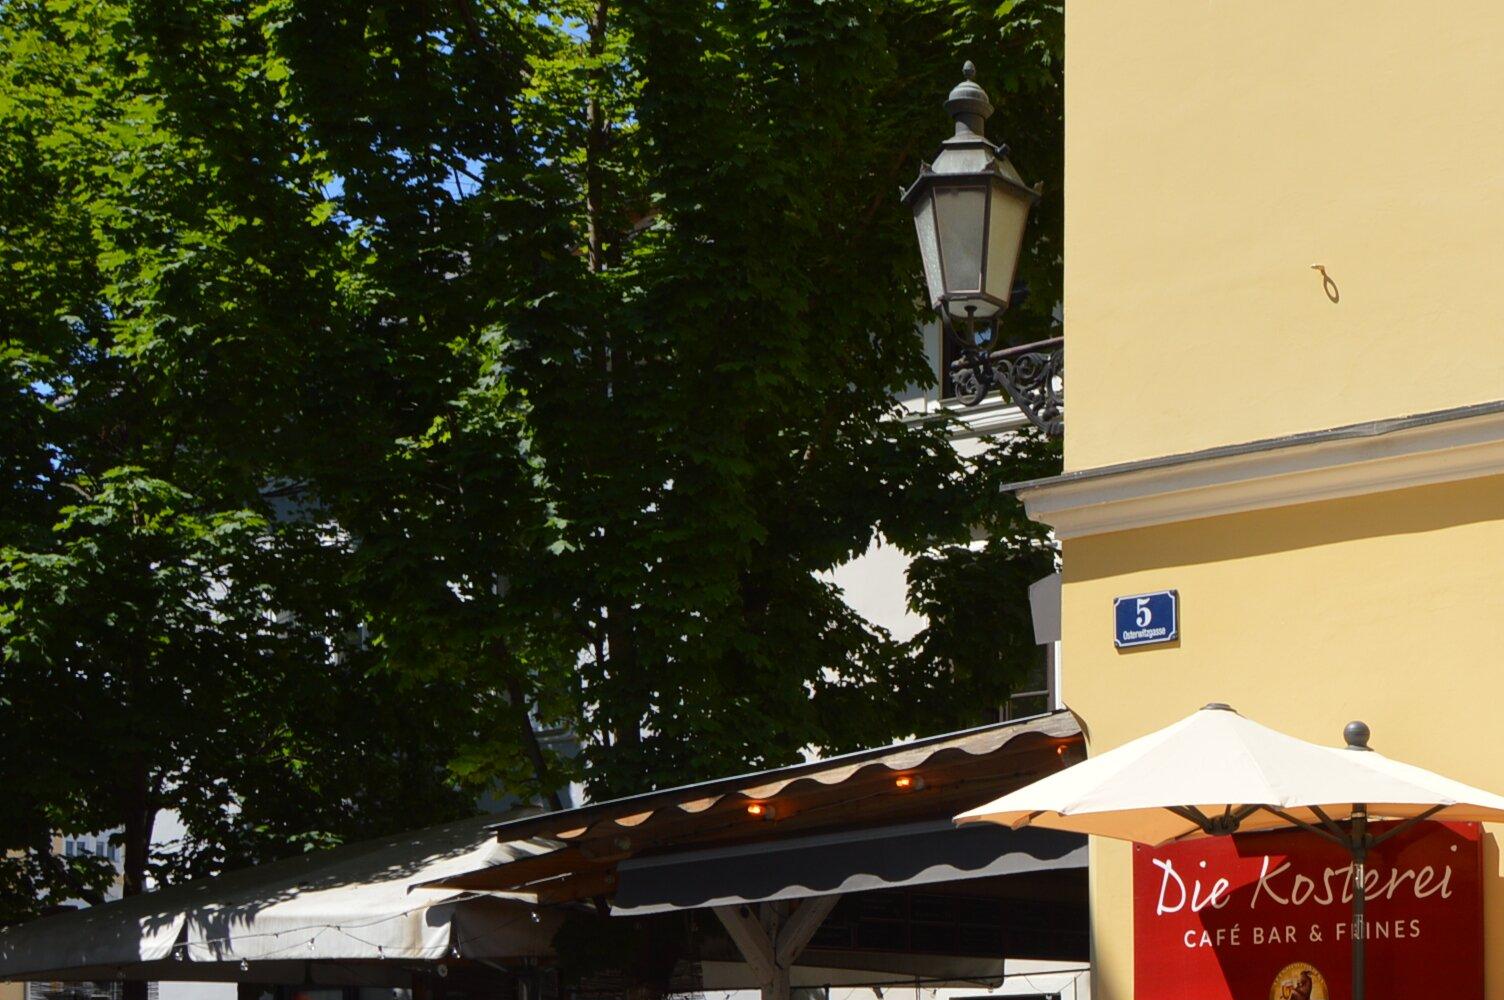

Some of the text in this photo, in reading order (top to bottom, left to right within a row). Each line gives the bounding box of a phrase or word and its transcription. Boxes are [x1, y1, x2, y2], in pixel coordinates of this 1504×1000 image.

[1136, 598, 1152, 627] 5
[1153, 845, 1457, 916] Die Kosterei
[1184, 923, 1240, 948] CAFÉ
[1253, 925, 1297, 945] BAR
[1309, 924, 1323, 942] &
